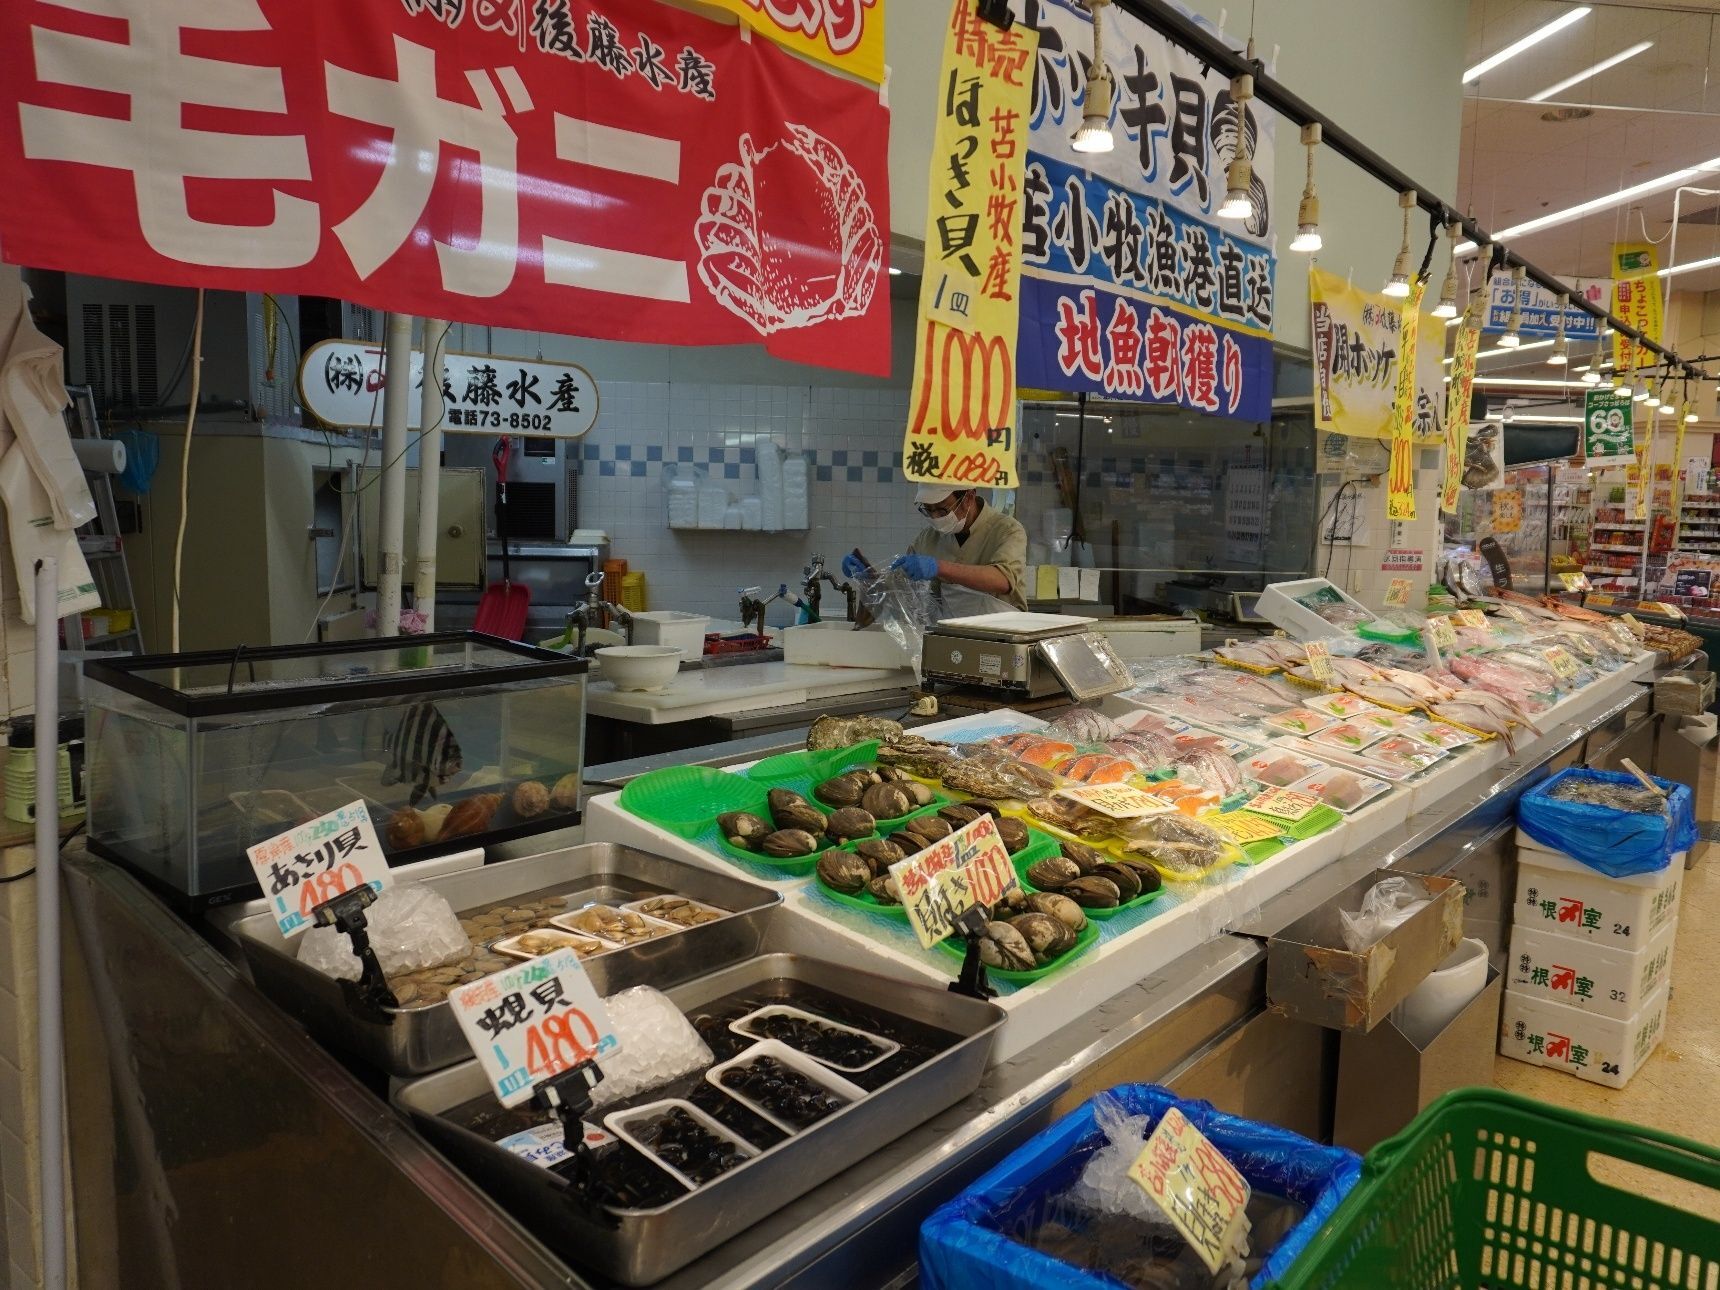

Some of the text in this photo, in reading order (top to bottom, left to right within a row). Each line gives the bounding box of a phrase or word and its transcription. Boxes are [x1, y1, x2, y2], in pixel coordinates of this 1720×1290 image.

[531, 0, 717, 101] 後藤水産
[18, 0, 691, 303] 毛ガニ
[937, 67, 982, 277] ほっき貝
[981, 106, 1020, 302] 苫小牧産
[1057, 293, 1242, 412] 地魚朝獲り
[448, 408, 552, 431] 電話73-8502
[267, 825, 368, 895] あさり貝
[1612, 922, 1631, 937] 24
[1609, 989, 1627, 1003] 32
[1601, 1062, 1620, 1076] 24
